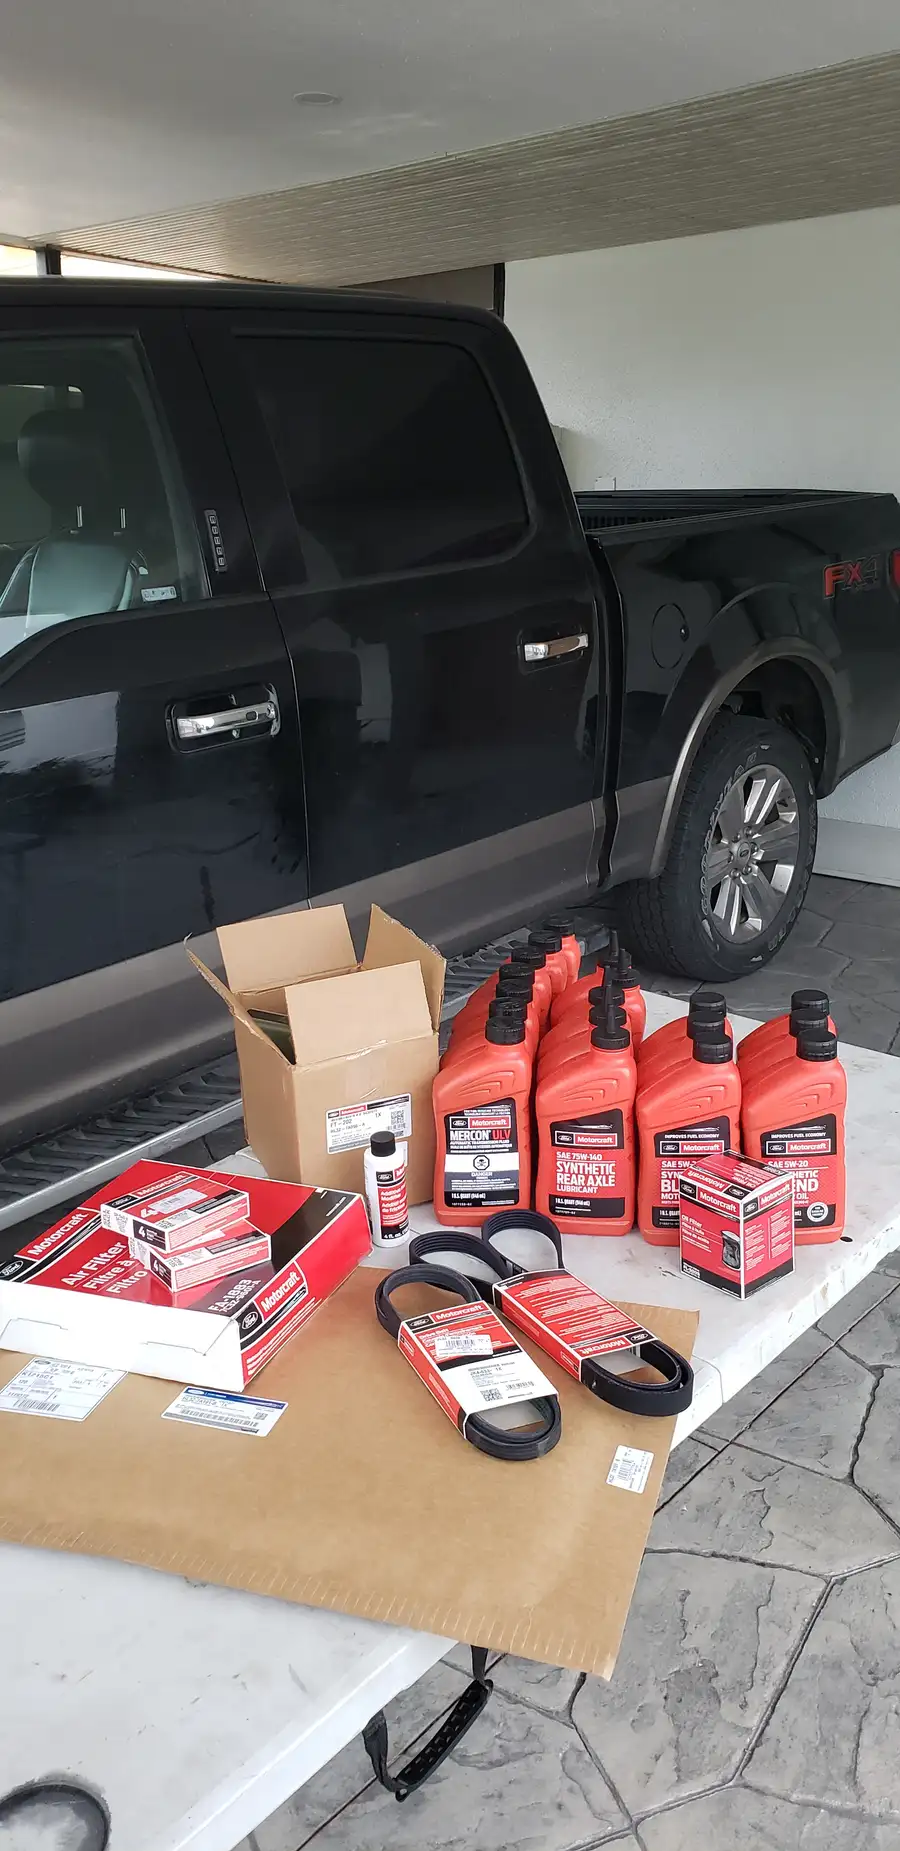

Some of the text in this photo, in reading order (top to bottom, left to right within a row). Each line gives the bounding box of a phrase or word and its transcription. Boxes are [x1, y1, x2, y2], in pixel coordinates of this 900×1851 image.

[824, 556, 878, 599] FX4
[492, 1129, 511, 1139] ULV
[556, 1161, 616, 1175] SYNTHETIC
[784, 1160, 809, 1168] 5W-20
[139, 1174, 185, 1196] Motorcraft
[556, 1173, 616, 1187] REAR AXLE
[687, 1170, 725, 1188] Motorcraft
[556, 1185, 598, 1193] LUBRICANT
[760, 1183, 791, 1205] Motorcraft
[700, 1191, 737, 1212] Motorcraft
[27, 1213, 89, 1256] Motorcraft
[138, 1226, 146, 1238] 4
[61, 1242, 128, 1286] Air Filter
[153, 1259, 159, 1270] 4
[83, 1265, 125, 1289] Filtre
[106, 1270, 148, 1293] Filtro
[208, 1279, 252, 1312] FA-1883
[260, 1271, 301, 1312] Motorcraft
[435, 1304, 484, 1320] Motorcraft
[580, 1340, 626, 1355] Motorcraft
